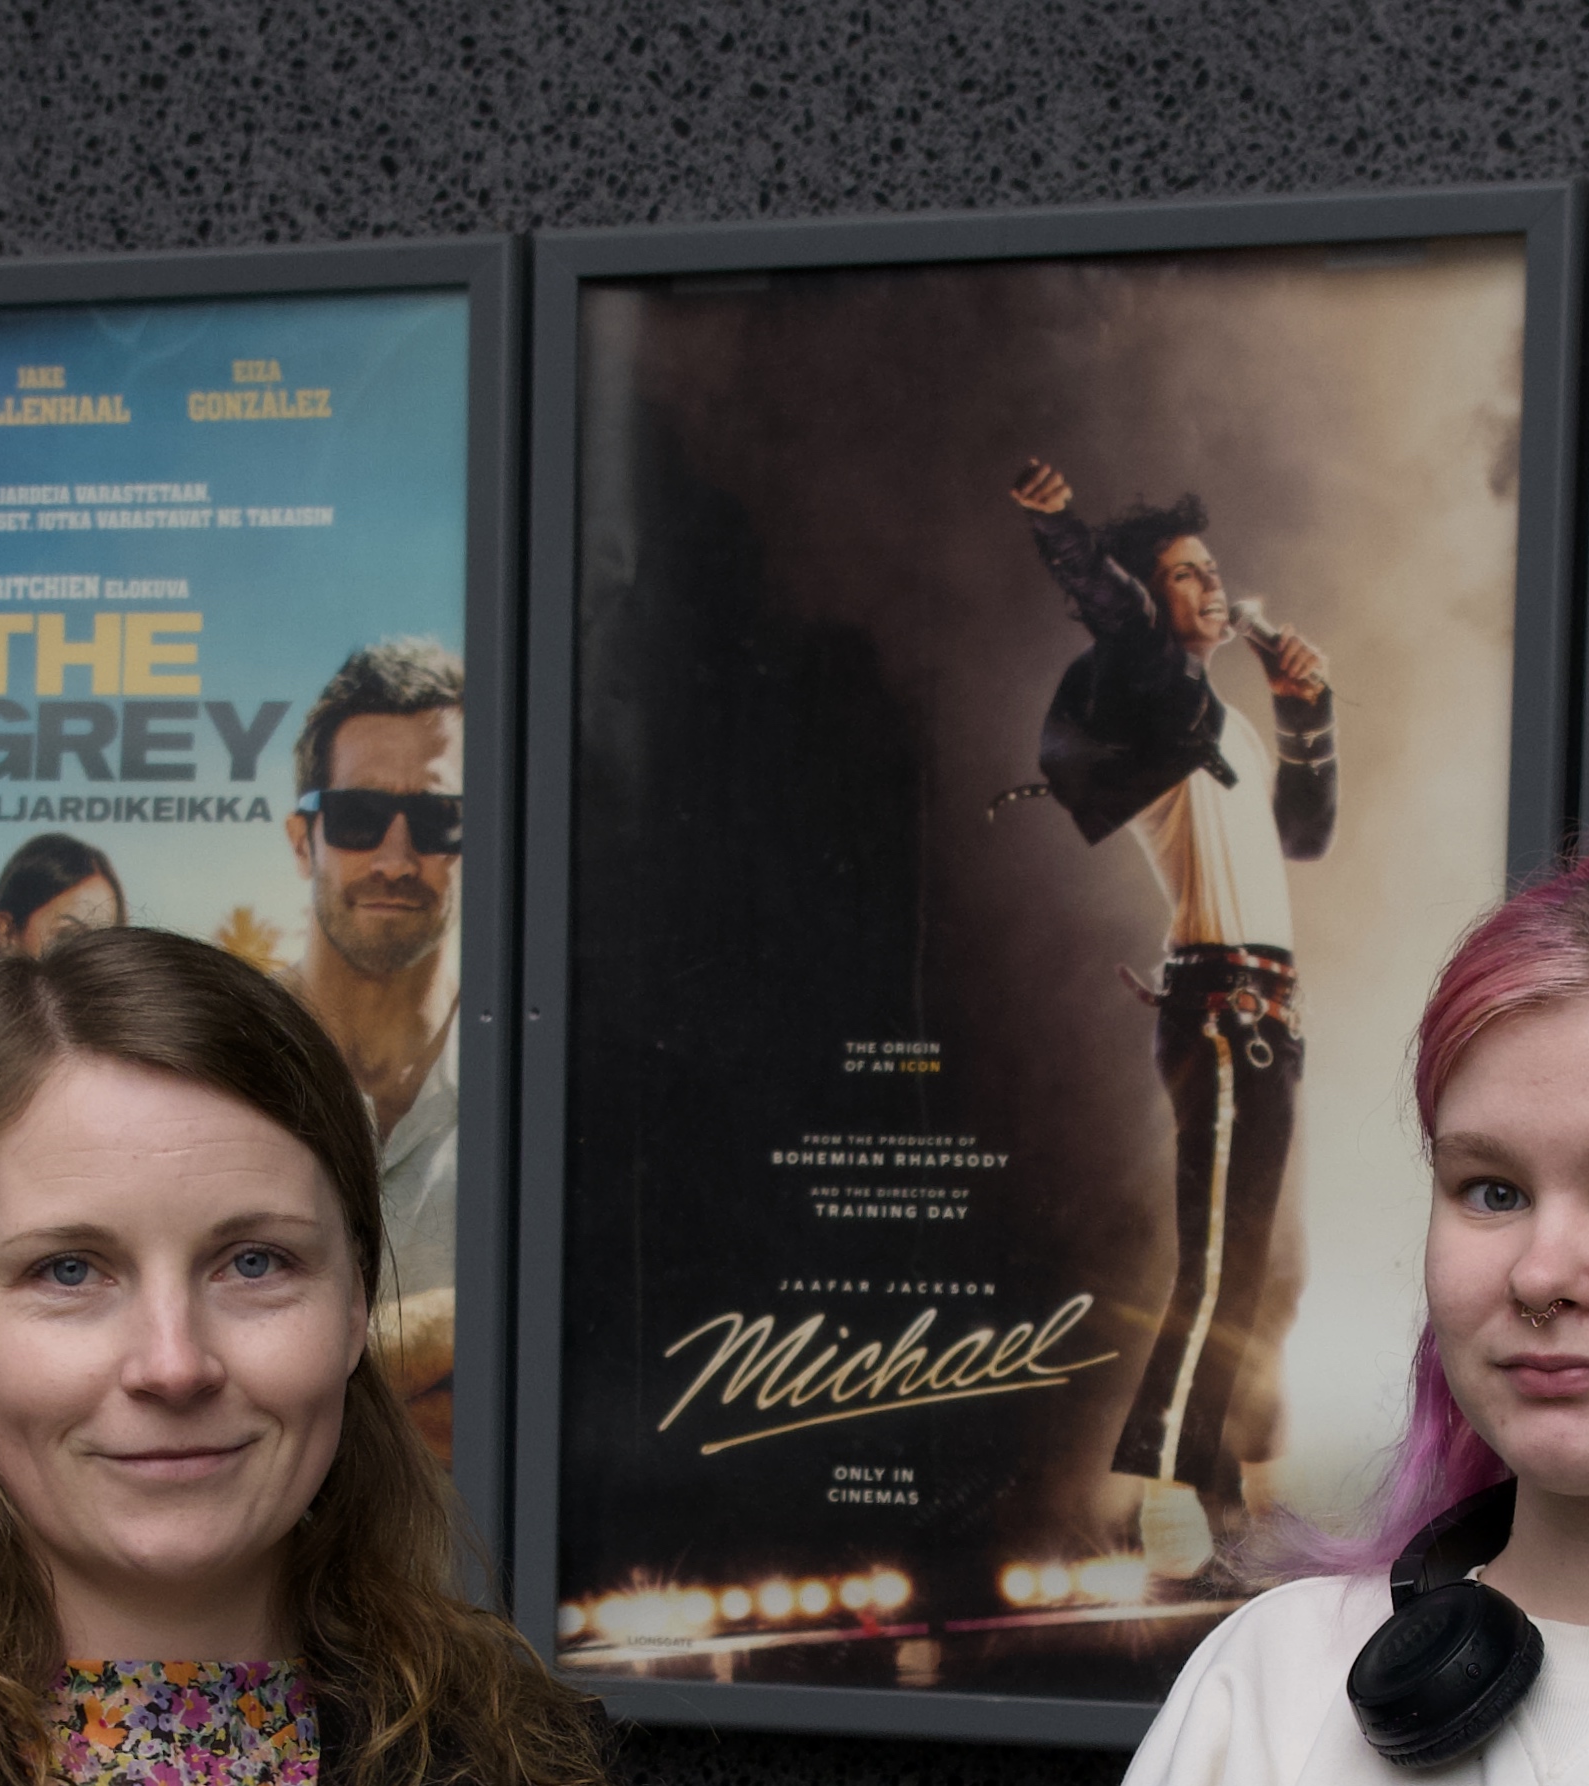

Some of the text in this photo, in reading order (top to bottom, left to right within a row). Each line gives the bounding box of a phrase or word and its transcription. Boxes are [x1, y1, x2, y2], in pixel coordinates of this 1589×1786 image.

[17, 367, 65, 389] JAKE
[232, 360, 282, 383] EIZA
[37, 510, 92, 530] JOTKA
[97, 508, 212, 529] VARASTAVAT
[217, 508, 243, 527] NE
[248, 506, 334, 527] TAKAISIN
[105, 579, 189, 599] ELOKUVA
[846, 1041, 940, 1055] THE ORIGIN
[844, 1060, 941, 1073] OF AN ICON
[803, 1135, 977, 1147] FROM THE PRODUCER OF
[772, 1151, 1009, 1168] BOHEMIAN RHAPSODY
[811, 1187, 970, 1200] AND THE DIRECTOR OF
[816, 1204, 969, 1221] TRAINING DAY
[779, 1279, 996, 1297] JAAFAR JACKSON
[657, 1293, 1119, 1433] Michael
[834, 1467, 914, 1483] ONLY IN
[828, 1489, 919, 1506] CINEMAS
[628, 1636, 693, 1648] LIONSGATE
